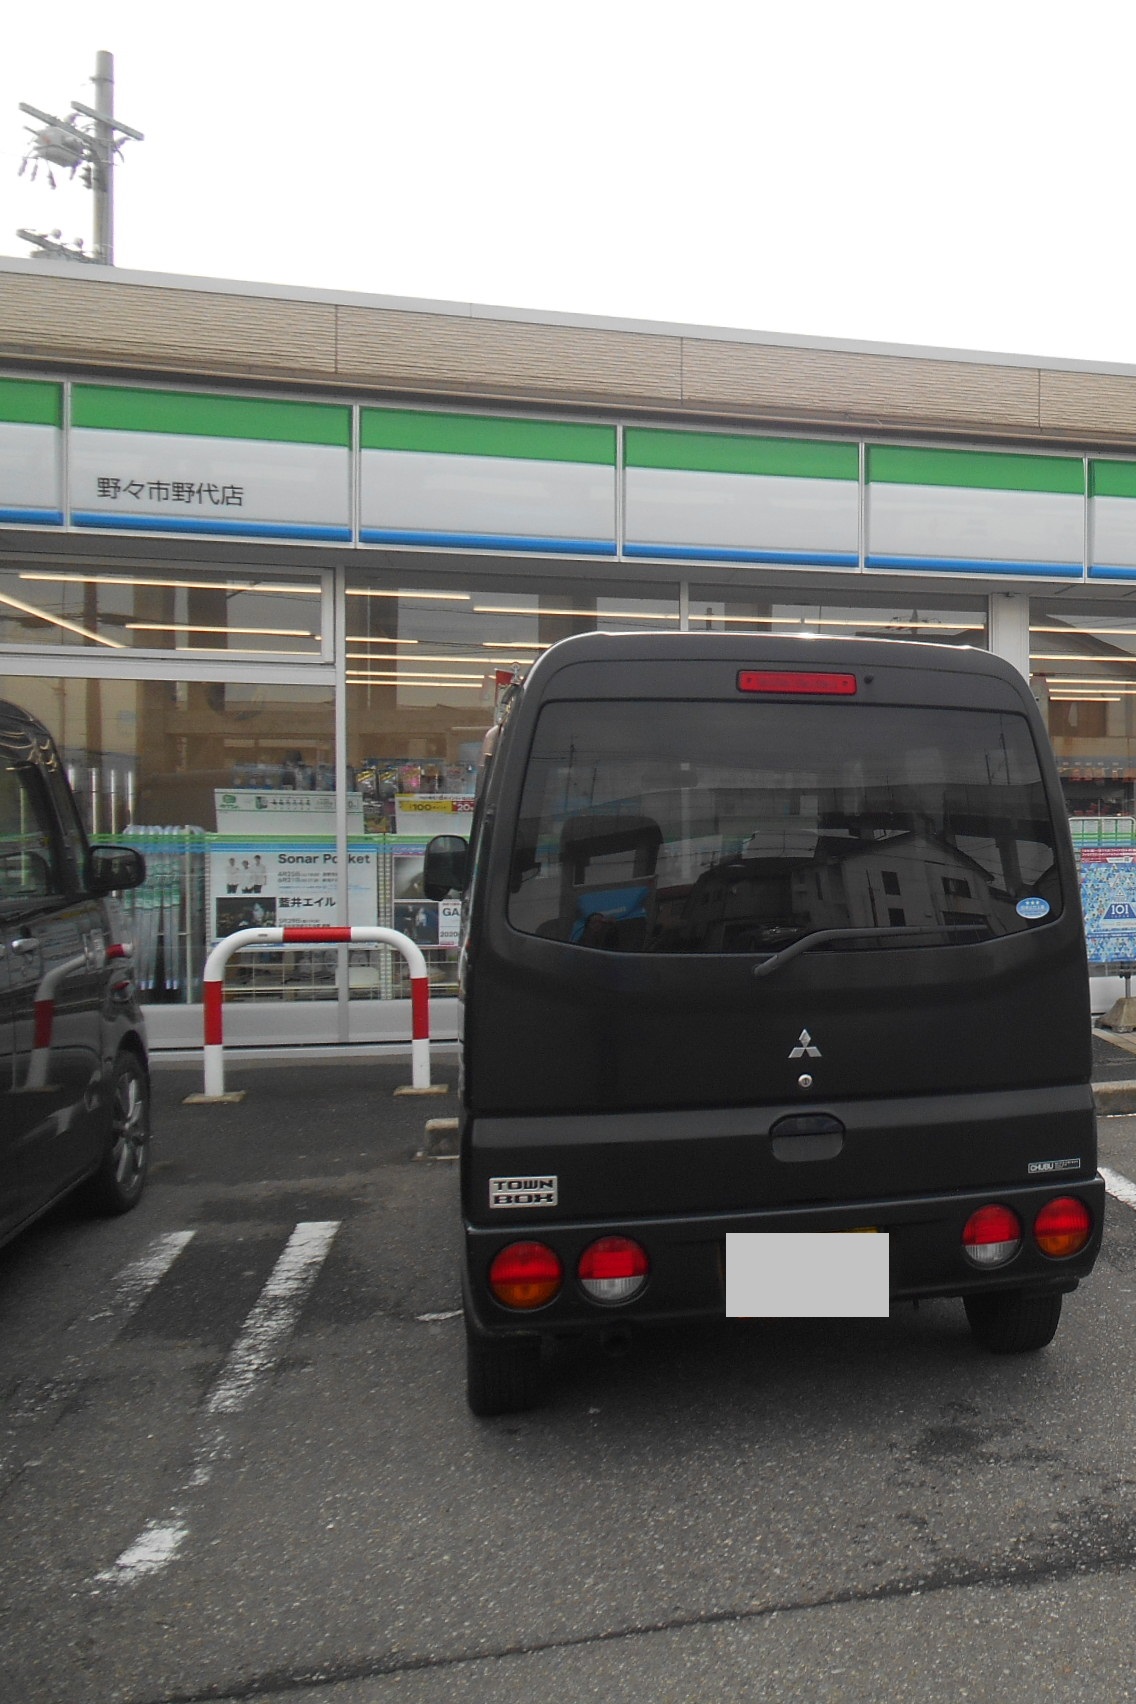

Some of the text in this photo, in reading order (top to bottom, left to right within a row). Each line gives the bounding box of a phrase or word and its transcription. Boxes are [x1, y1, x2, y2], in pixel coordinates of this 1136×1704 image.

[97, 477, 244, 507] 野々市野代店
[278, 854, 370, 864] Sonar Poket
[279, 897, 336, 908] 藍井エイル
[1111, 904, 1129, 915] 101
[493, 1179, 553, 1191] TOWN
[494, 1193, 553, 1205] BOX
